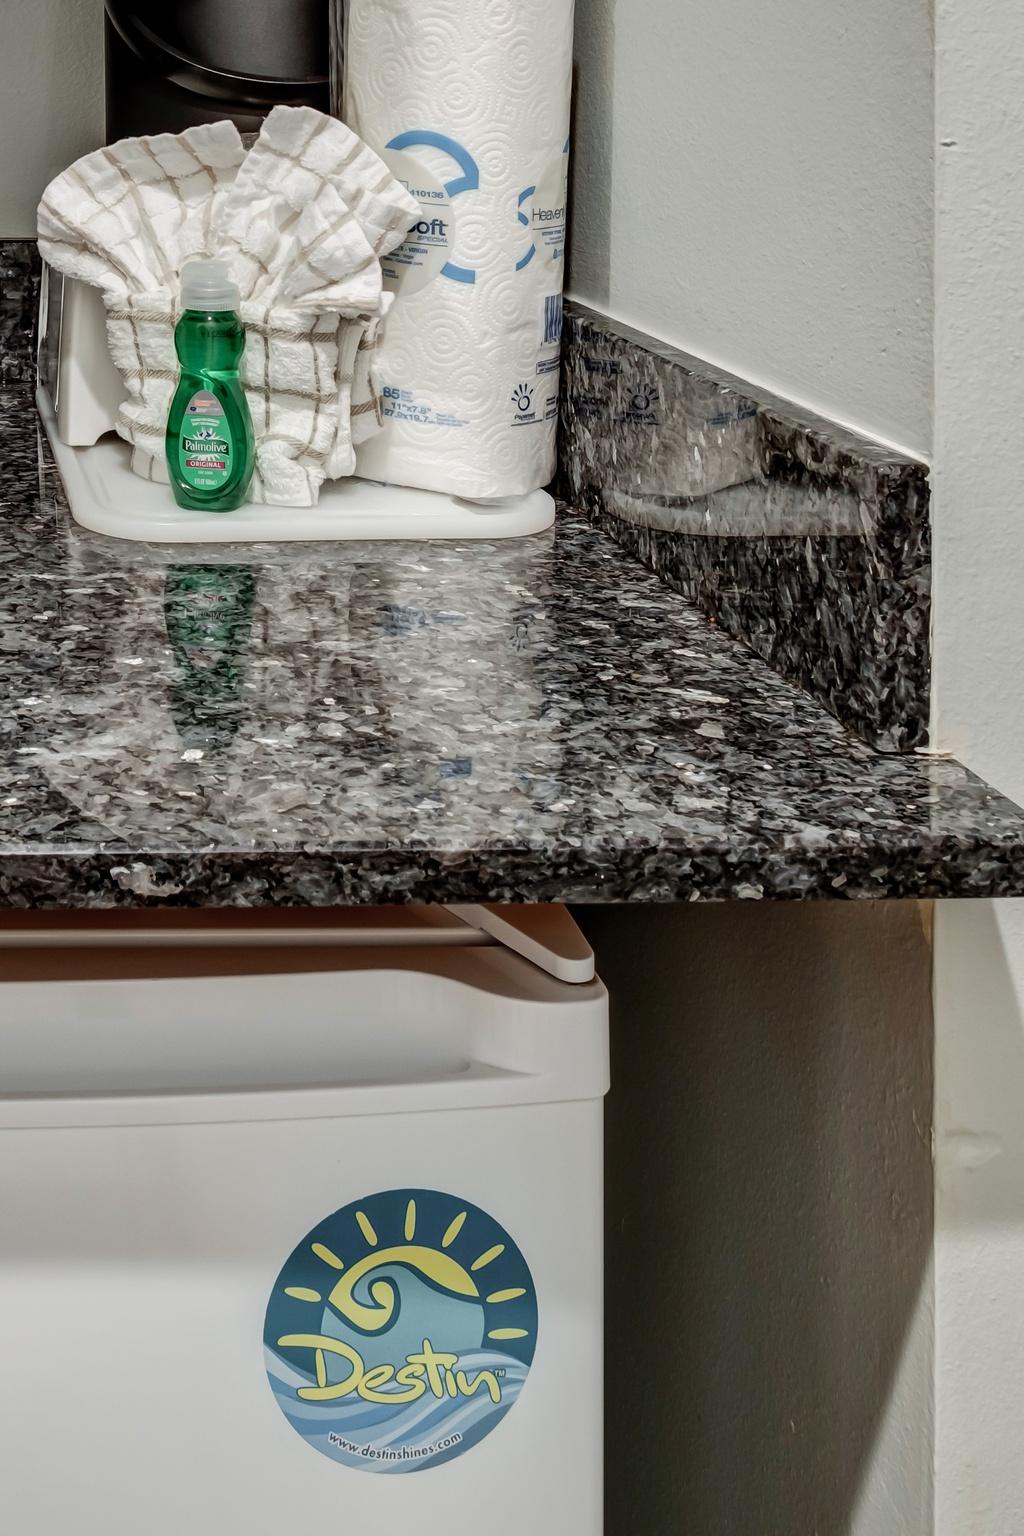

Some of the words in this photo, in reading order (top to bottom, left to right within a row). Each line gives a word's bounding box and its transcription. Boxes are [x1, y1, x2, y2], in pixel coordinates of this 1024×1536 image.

[383, 386, 400, 399] 85
[185, 438, 228, 453] Palmolive
[190, 460, 222, 468] ORIGINAL
[277, 1333, 503, 1404] Destin
[328, 1431, 462, 1461] www.destinshines.com
